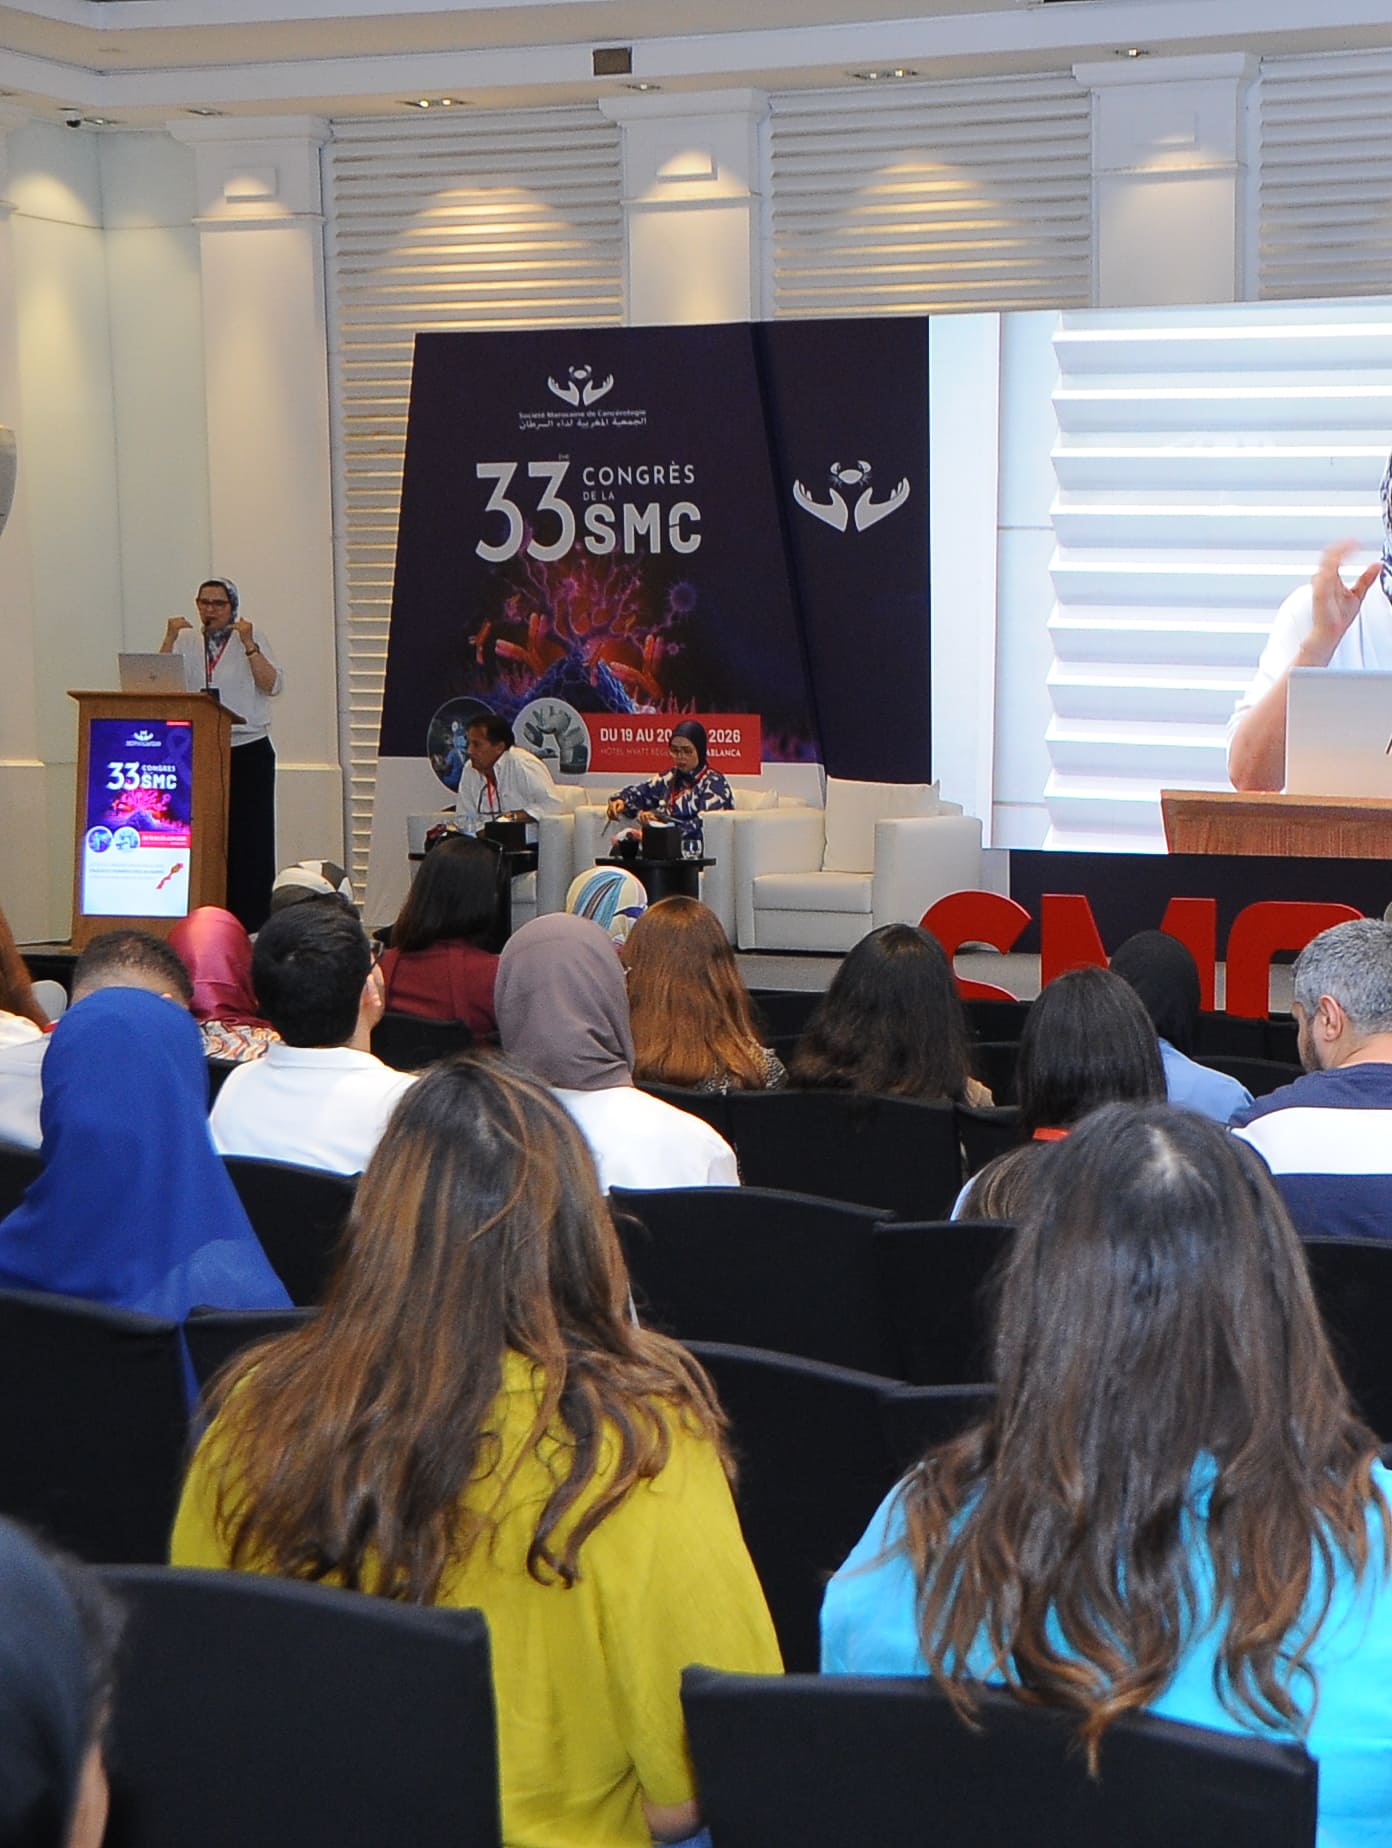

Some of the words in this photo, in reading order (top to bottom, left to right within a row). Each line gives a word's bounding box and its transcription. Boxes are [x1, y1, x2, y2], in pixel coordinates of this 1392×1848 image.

[583, 491, 597, 501] DE
[601, 490, 615, 501] LA
[475, 461, 576, 562] 33
[582, 460, 696, 486] CONGRÈS
[583, 501, 702, 555] SMC
[600, 728, 618, 742] DU
[620, 727, 633, 742] 19
[636, 728, 654, 742] AU
[708, 728, 741, 743] 2026
[706, 748, 741, 758] ABLANCA
[106, 761, 140, 790] 33
[141, 774, 177, 789] SMC
